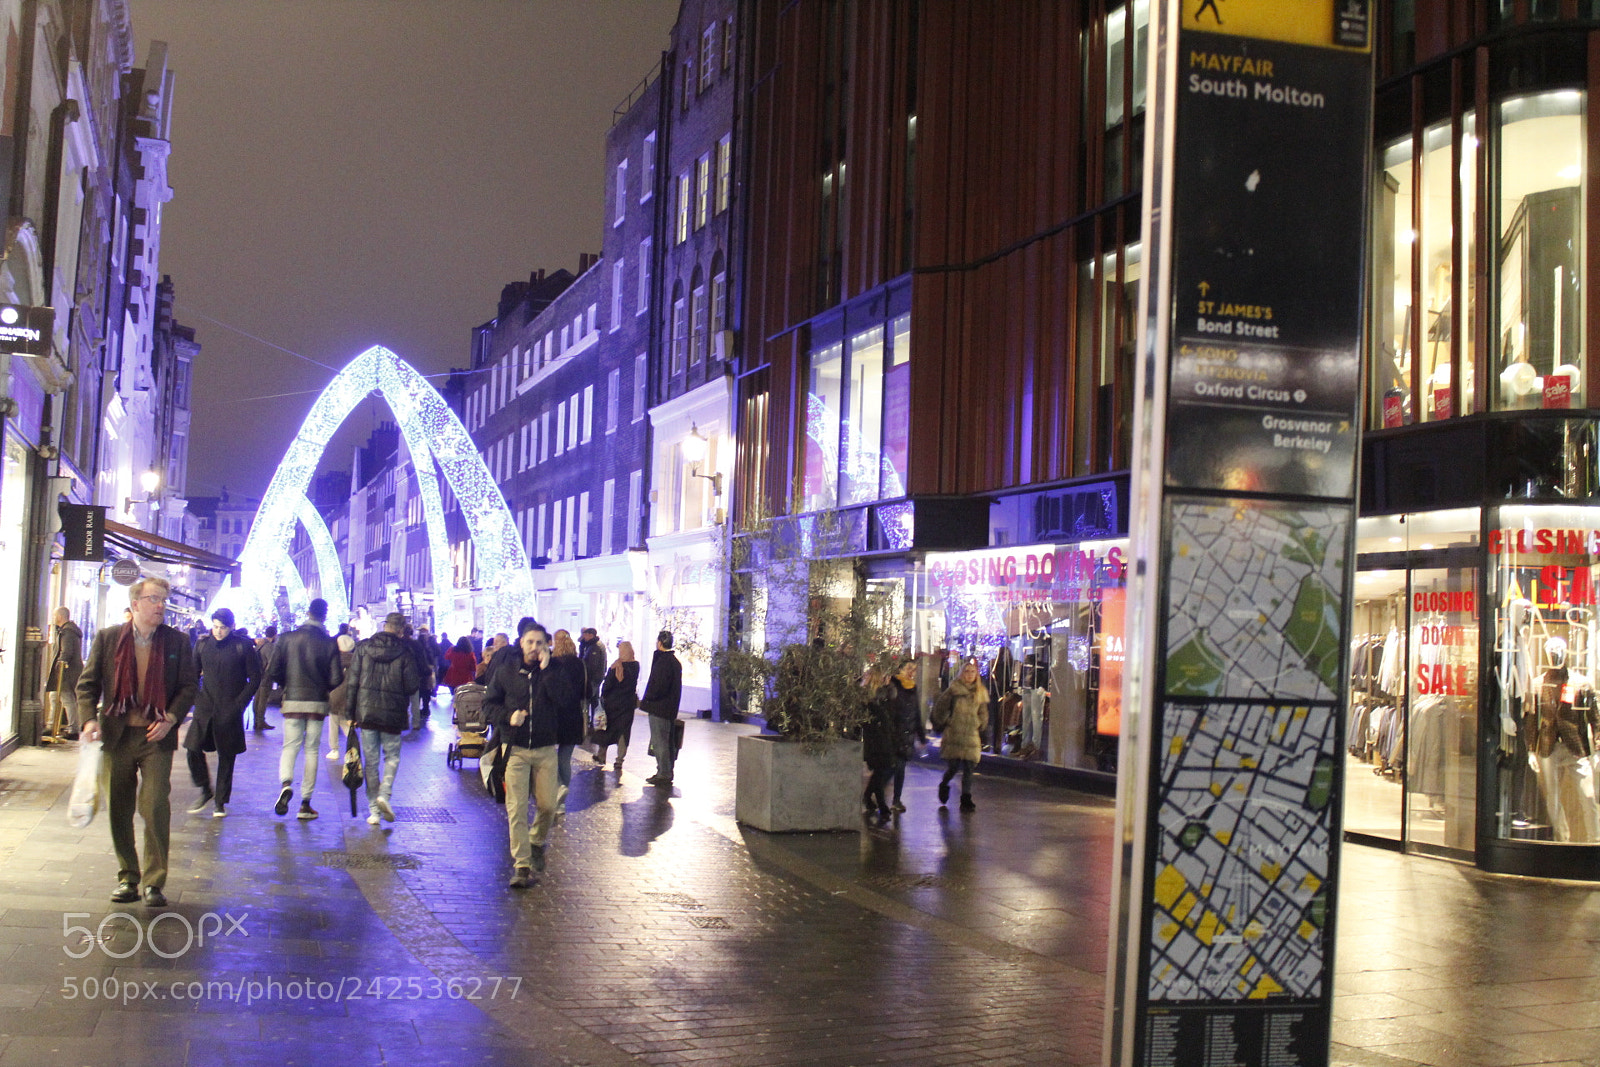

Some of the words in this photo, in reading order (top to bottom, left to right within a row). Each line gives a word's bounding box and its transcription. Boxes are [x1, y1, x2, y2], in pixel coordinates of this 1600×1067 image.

[1190, 51, 1274, 77] MAYFAIR
[1189, 74, 1247, 99] South
[1254, 82, 1325, 108] Molton
[1198, 301, 1214, 316] ST
[1217, 303, 1273, 320] JAMES'S
[1197, 319, 1232, 335] Bond
[1236, 321, 1279, 338] Street
[1196, 346, 1238, 361] SOHO
[1194, 381, 1243, 398] Oxford
[1247, 385, 1290, 402] Circus
[1545, 383, 1567, 398] sale
[1262, 415, 1332, 433] Grosvenor
[1274, 434, 1332, 453] Berkeley
[1488, 529, 1600, 554] CLOSING
[931, 555, 1017, 587] CLOSING
[1025, 549, 1095, 583] DOWN
[1107, 547, 1128, 579] S
[1087, 587, 1103, 600] GO
[1413, 591, 1474, 612] CLOSING
[1106, 636, 1126, 652] SA
[1421, 626, 1465, 646] DOWN
[1417, 664, 1468, 696] SALE
